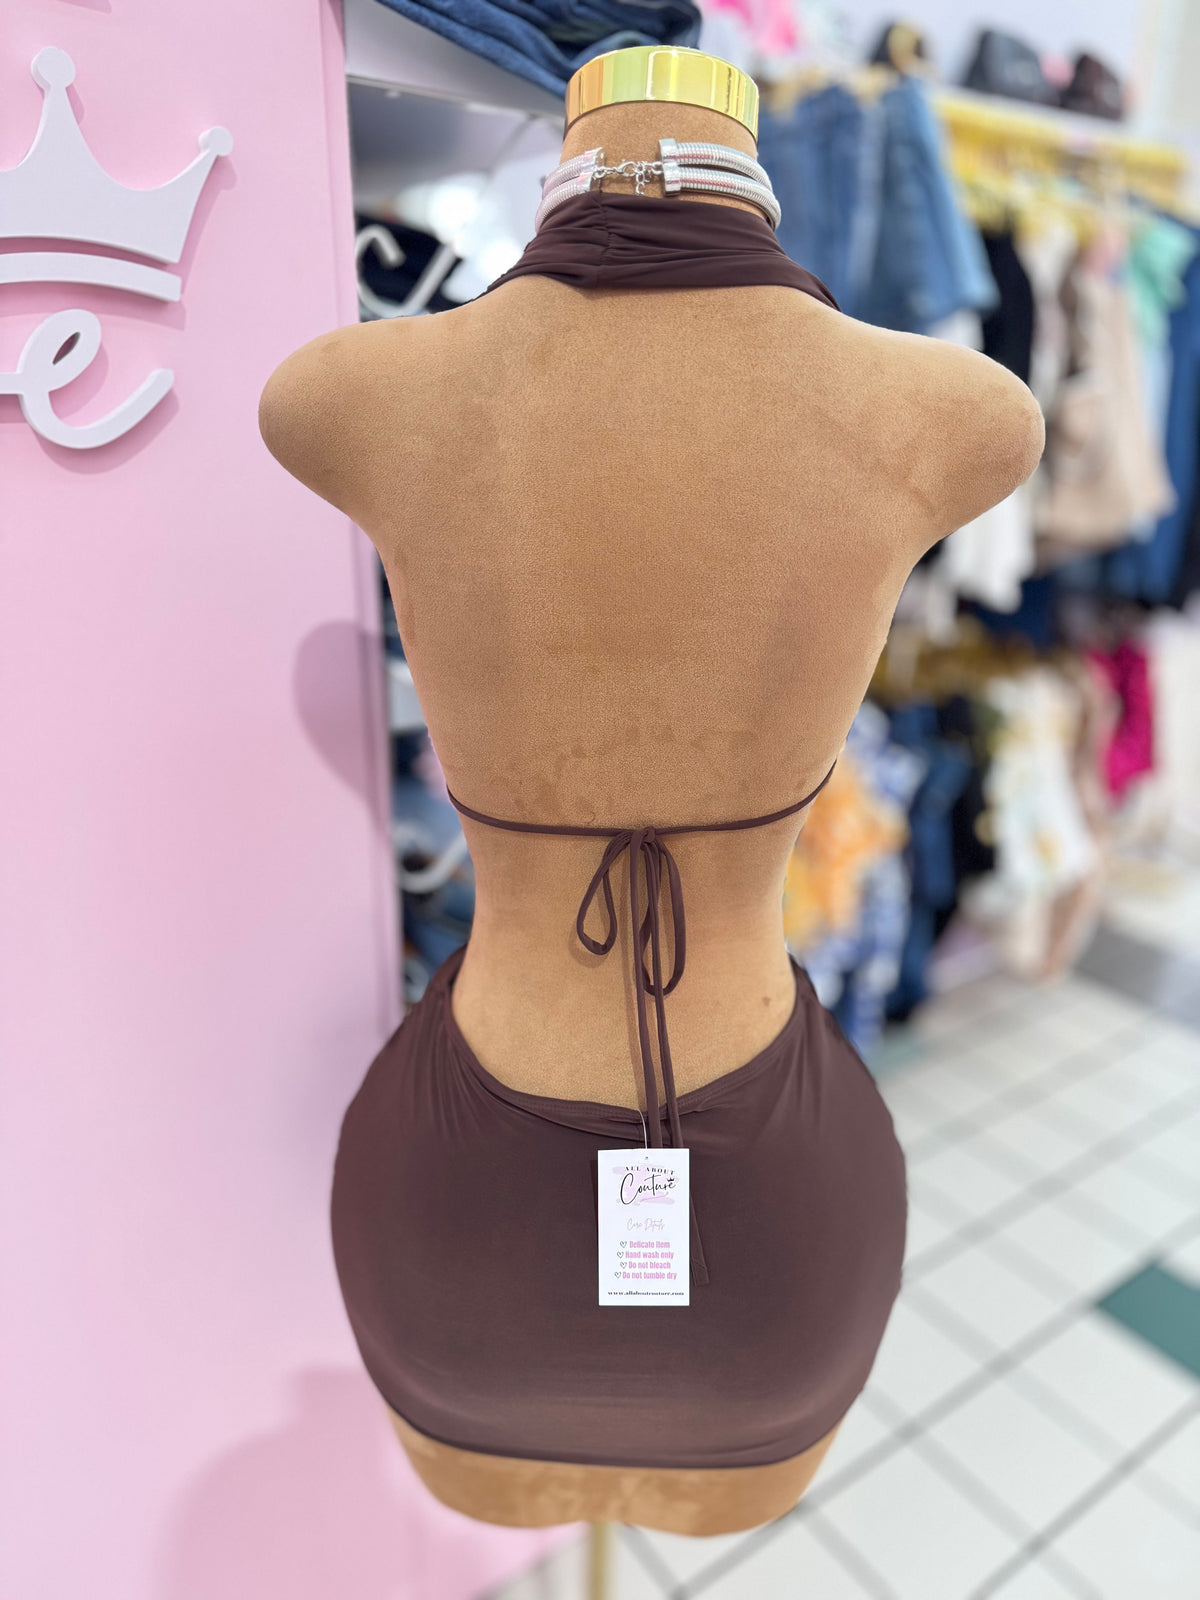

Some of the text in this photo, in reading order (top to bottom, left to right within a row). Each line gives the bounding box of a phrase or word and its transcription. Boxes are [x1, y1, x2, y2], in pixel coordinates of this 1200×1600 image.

[646, 1167, 675, 1175] ABOUT
[620, 1172, 676, 1205] Couture
[629, 1240, 655, 1249] Delicate
[625, 1251, 674, 1260] Hand wash only
[628, 1261, 671, 1269] Do not bleach
[622, 1271, 678, 1281] Do not tumble dry
